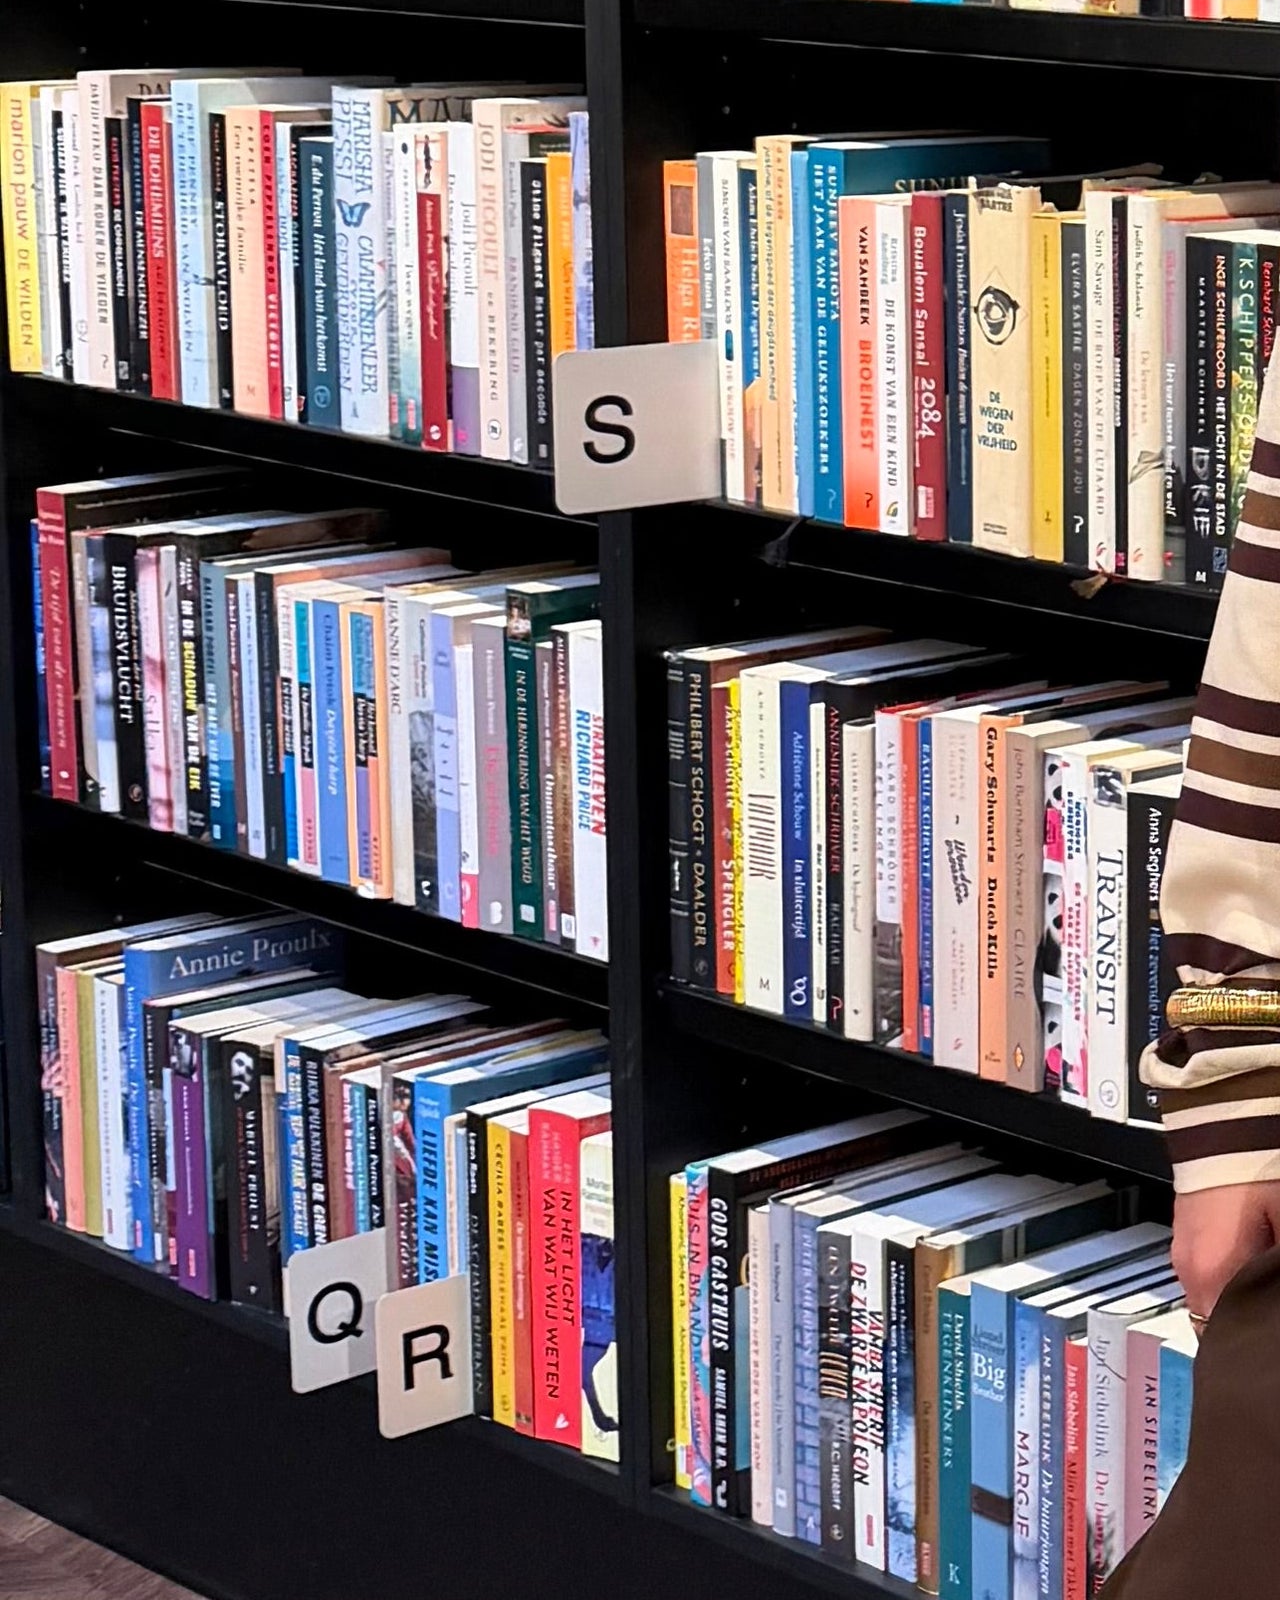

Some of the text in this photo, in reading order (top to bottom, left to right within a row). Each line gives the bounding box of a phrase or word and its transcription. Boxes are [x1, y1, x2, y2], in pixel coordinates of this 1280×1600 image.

[859, 340, 875, 453] BROEINEST
[918, 378, 943, 439] 2084
[582, 394, 637, 465] S
[111, 565, 134, 725] BRUIDSVLUCHT
[985, 726, 998, 770] Gary
[986, 877, 999, 928] Dutch
[169, 927, 333, 980] Annie Proulx
[986, 933, 997, 980] Kills
[1094, 850, 1125, 1025] TRANSIT
[710, 1197, 729, 1352] GODS GASTHUIS
[308, 1282, 365, 1345] Q
[402, 1325, 455, 1391] R
